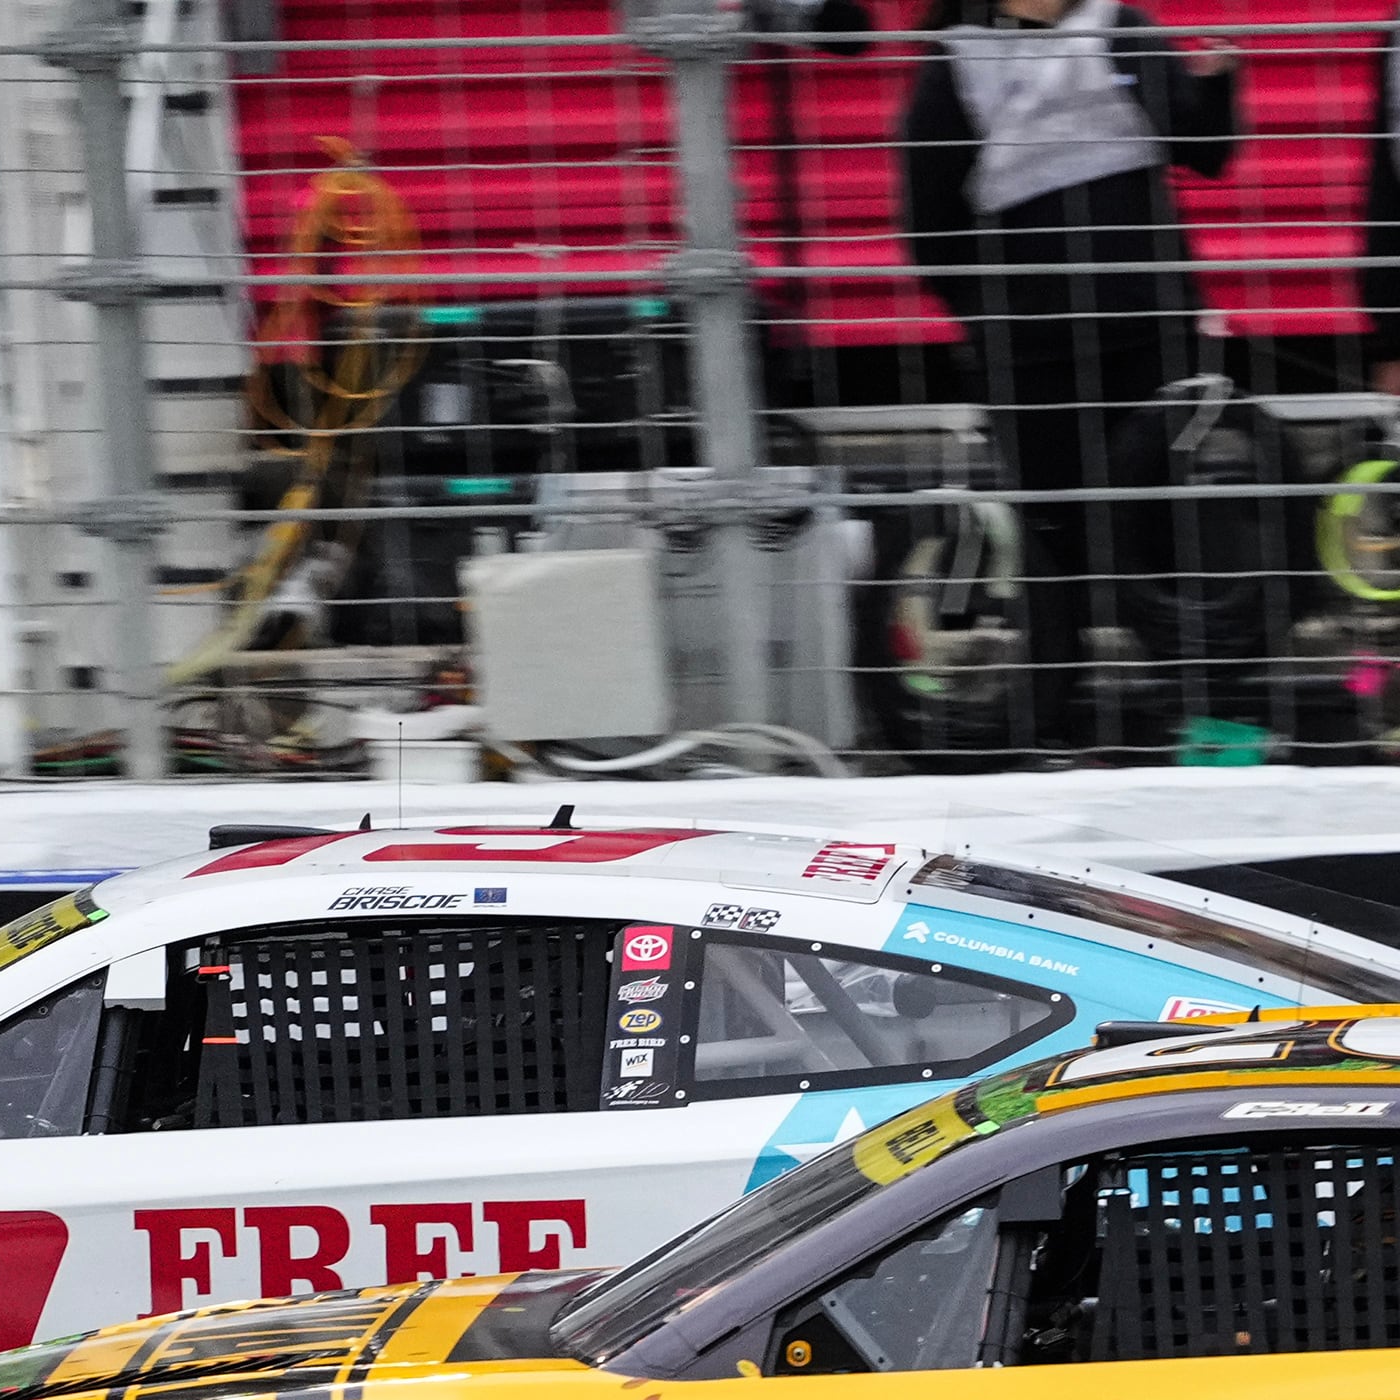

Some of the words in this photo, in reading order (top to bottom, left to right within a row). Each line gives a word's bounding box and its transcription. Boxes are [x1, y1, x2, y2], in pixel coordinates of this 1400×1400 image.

[342, 886, 414, 896] CHASE
[327, 894, 468, 911] BRISCOE
[933, 931, 1025, 963] COLUMBIA
[1029, 955, 1080, 977] BANK
[609, 1038, 637, 1049] FREE
[135, 1199, 587, 1319] FREE
